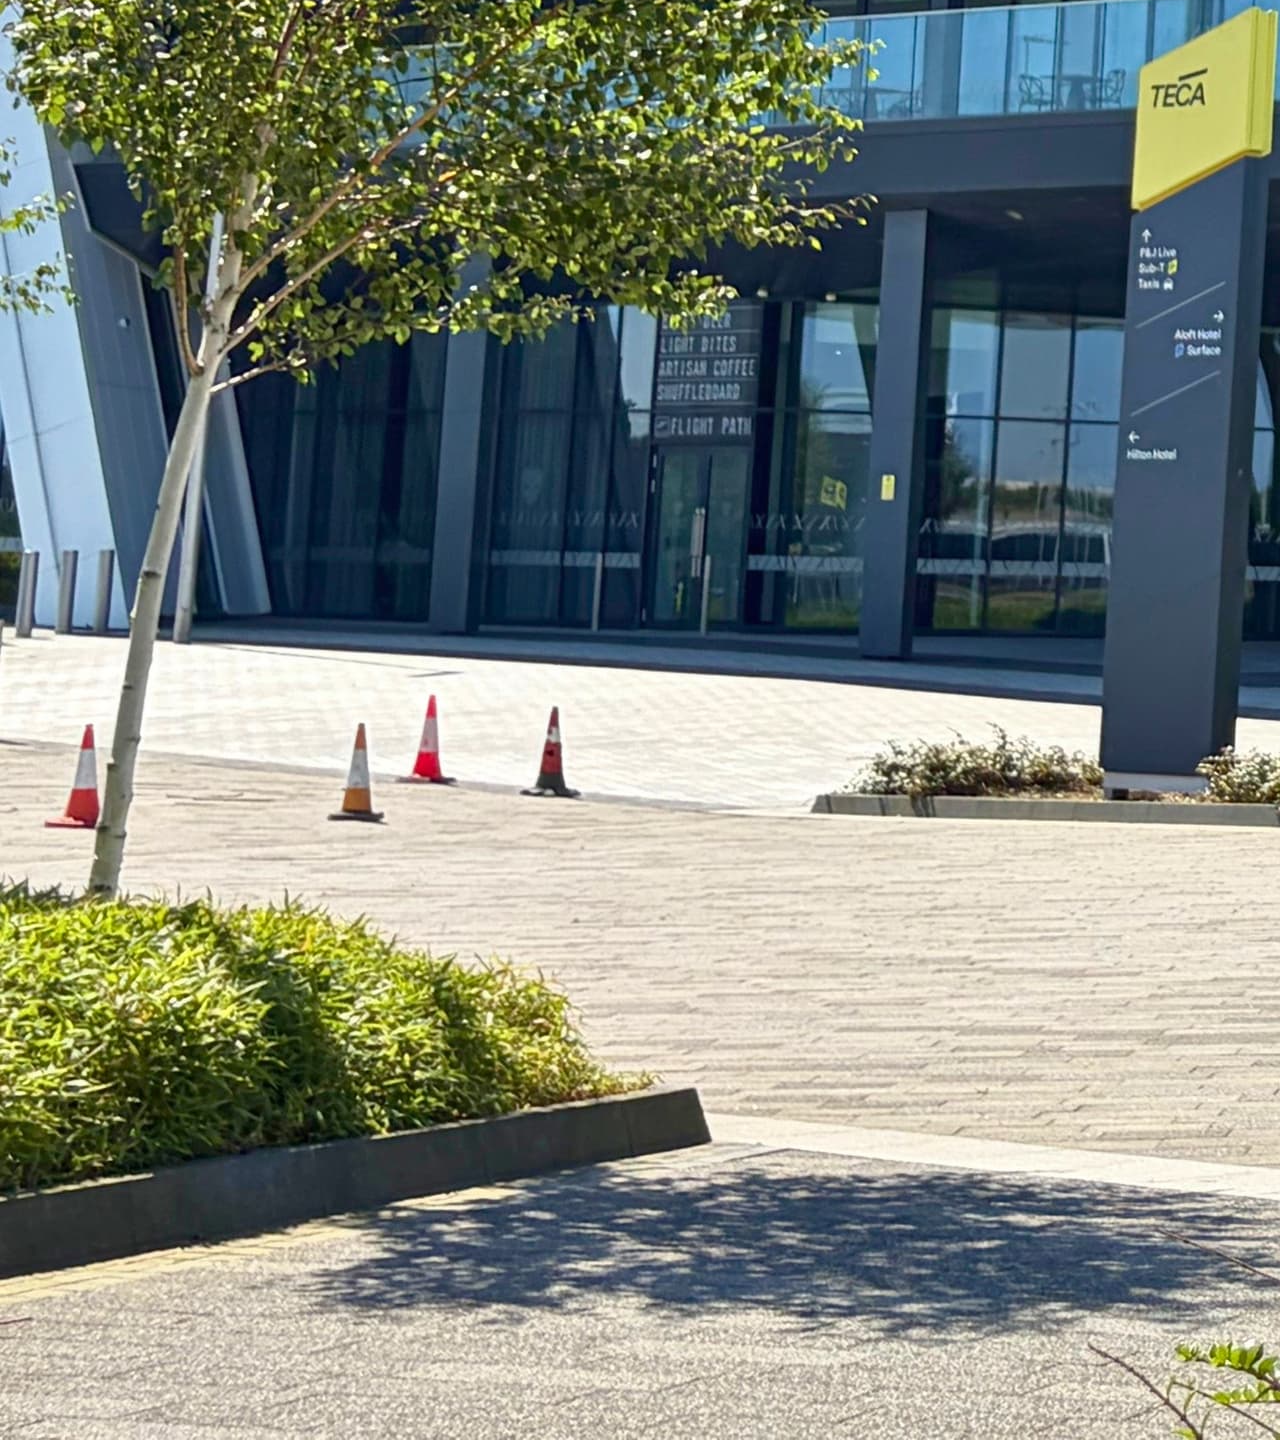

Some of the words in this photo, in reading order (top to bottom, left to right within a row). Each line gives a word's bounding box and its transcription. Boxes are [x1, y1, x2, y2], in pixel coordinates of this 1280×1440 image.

[1151, 73, 1207, 108] TECA
[1158, 246, 1177, 258] Live
[1138, 262, 1165, 274] Sub-T
[1138, 278, 1160, 289] Taxis
[1174, 328, 1196, 340] Aloft
[1197, 328, 1221, 340] Hotel
[660, 336, 695, 353] LIGHT
[701, 335, 737, 353] BITES
[1186, 343, 1221, 356] Surface
[658, 360, 707, 376] ARTISAN
[713, 359, 755, 376] COFFEE
[657, 383, 740, 401] SHUFFLEBOARD
[671, 416, 713, 436] FLIGHT
[721, 416, 752, 436] PATH
[1126, 448, 1152, 460] Hilton
[1152, 448, 1177, 460] Hotel
